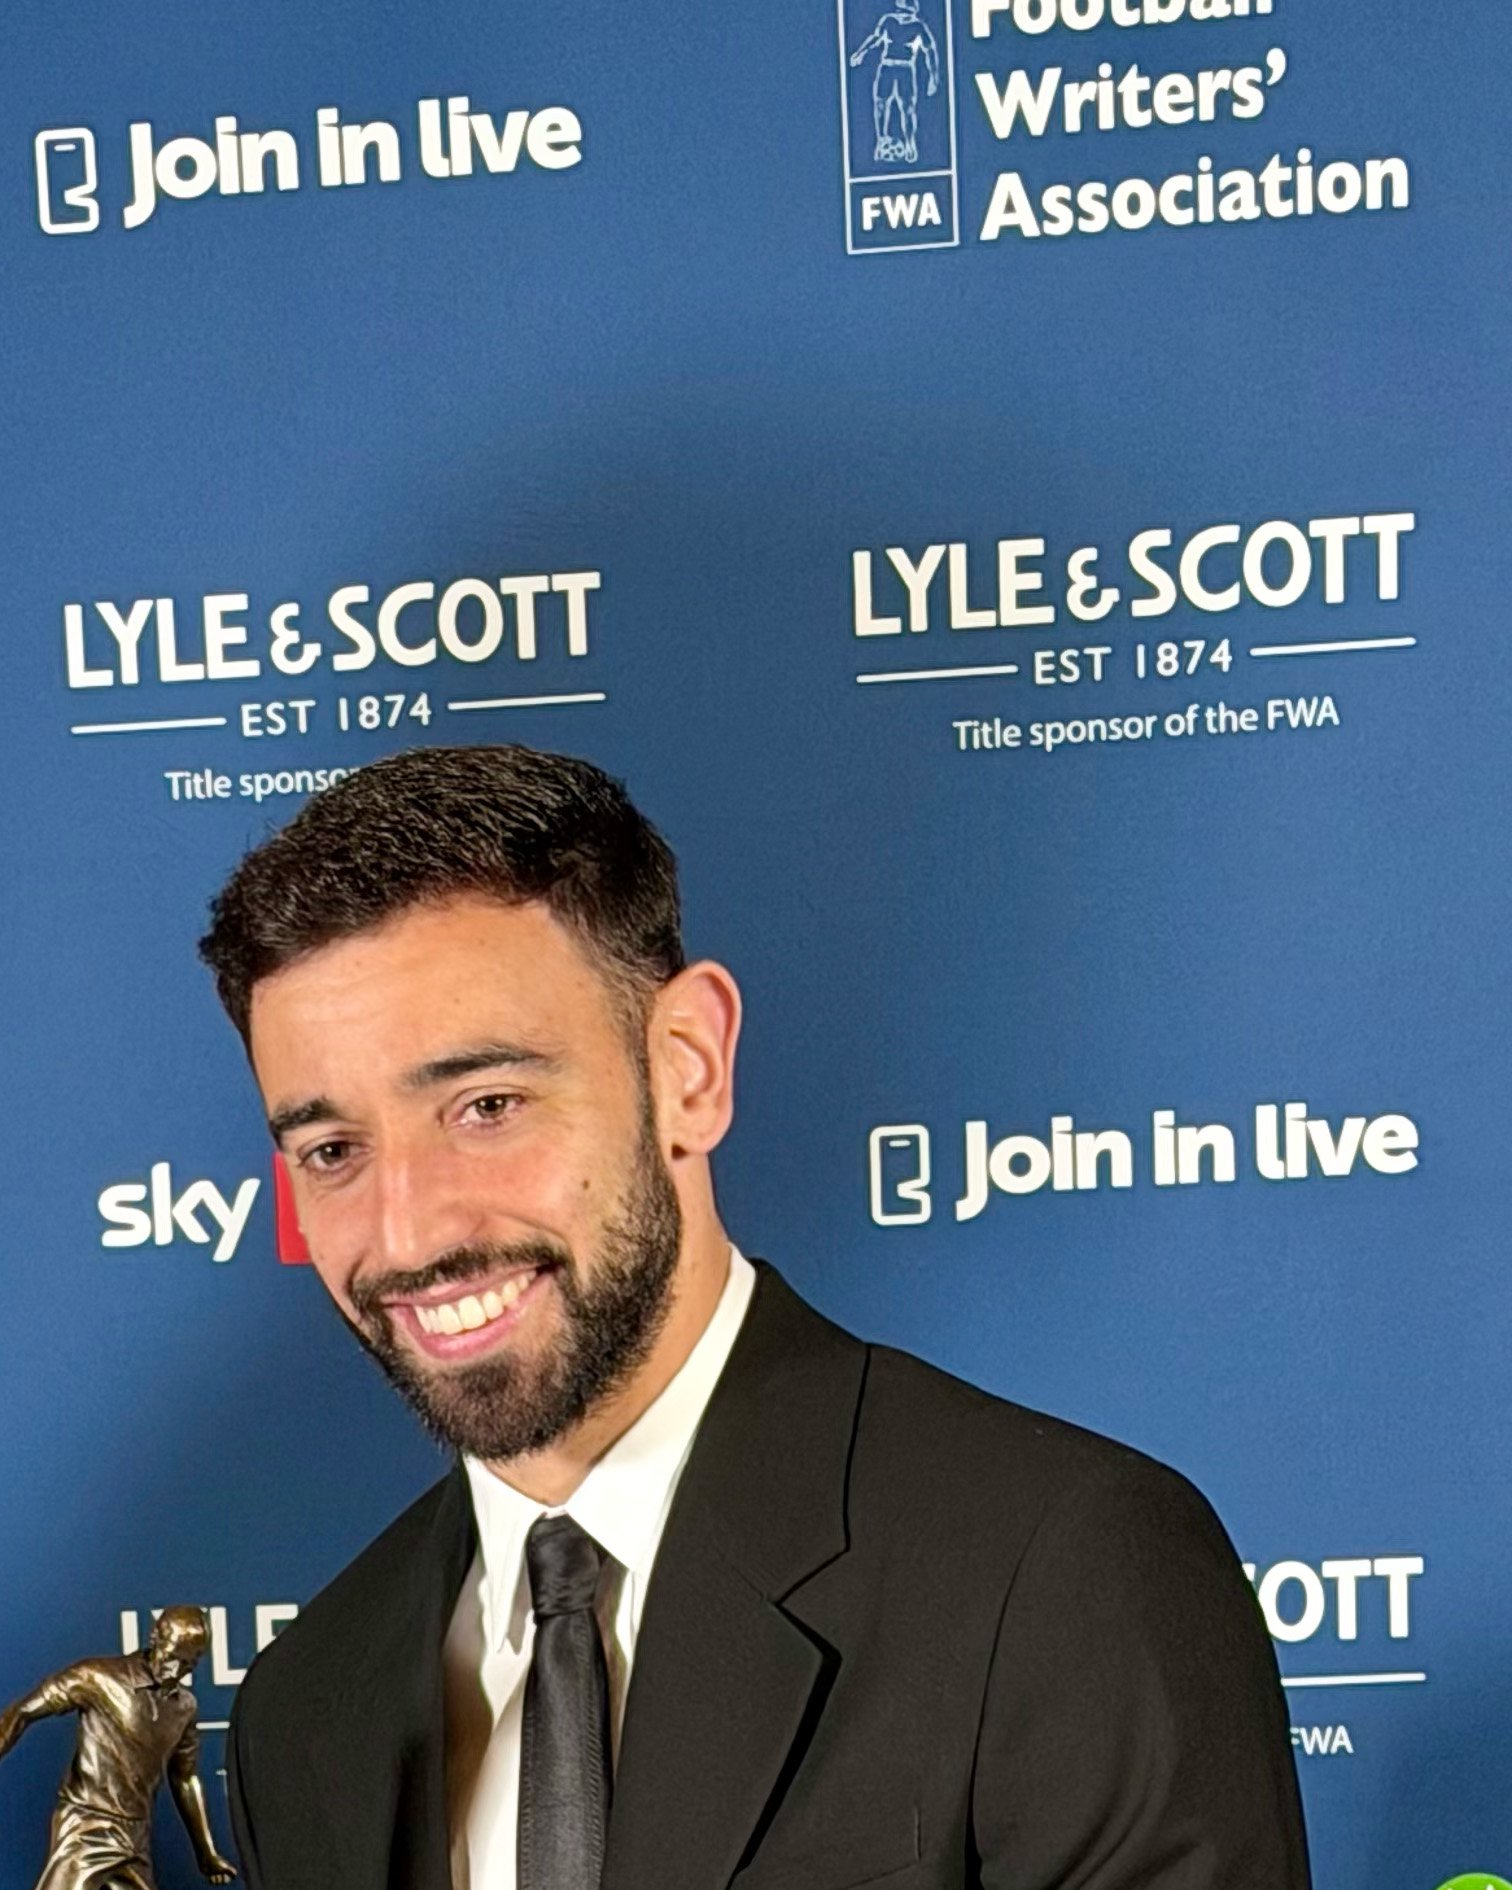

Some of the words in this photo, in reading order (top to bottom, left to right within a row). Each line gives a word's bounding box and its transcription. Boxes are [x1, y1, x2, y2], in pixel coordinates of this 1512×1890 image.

[974, 47, 1287, 140] Writers'
[123, 115, 300, 229] Join
[317, 107, 401, 187] in
[418, 96, 582, 178] live
[979, 147, 1409, 241] Association
[861, 192, 942, 231] FWA
[852, 537, 1055, 637] LYLE
[1128, 512, 1415, 617] SCOTT
[64, 593, 261, 689] LYLE
[328, 571, 601, 672] SCOTT
[1034, 646, 1112, 685] EST
[1136, 638, 1233, 678] 1874
[240, 699, 316, 737] EST
[339, 692, 432, 731] 1874
[952, 717, 1022, 750] Title
[1029, 715, 1158, 753] sponsor
[1164, 703, 1200, 736] of
[1205, 701, 1259, 734] the
[1267, 695, 1340, 730] FWA
[164, 768, 232, 801] Title
[955, 1115, 1133, 1222] Join
[1153, 1110, 1236, 1186] in
[1255, 1102, 1419, 1180] live
[97, 1161, 261, 1262] sky
[1241, 1556, 1424, 1642] OTT
